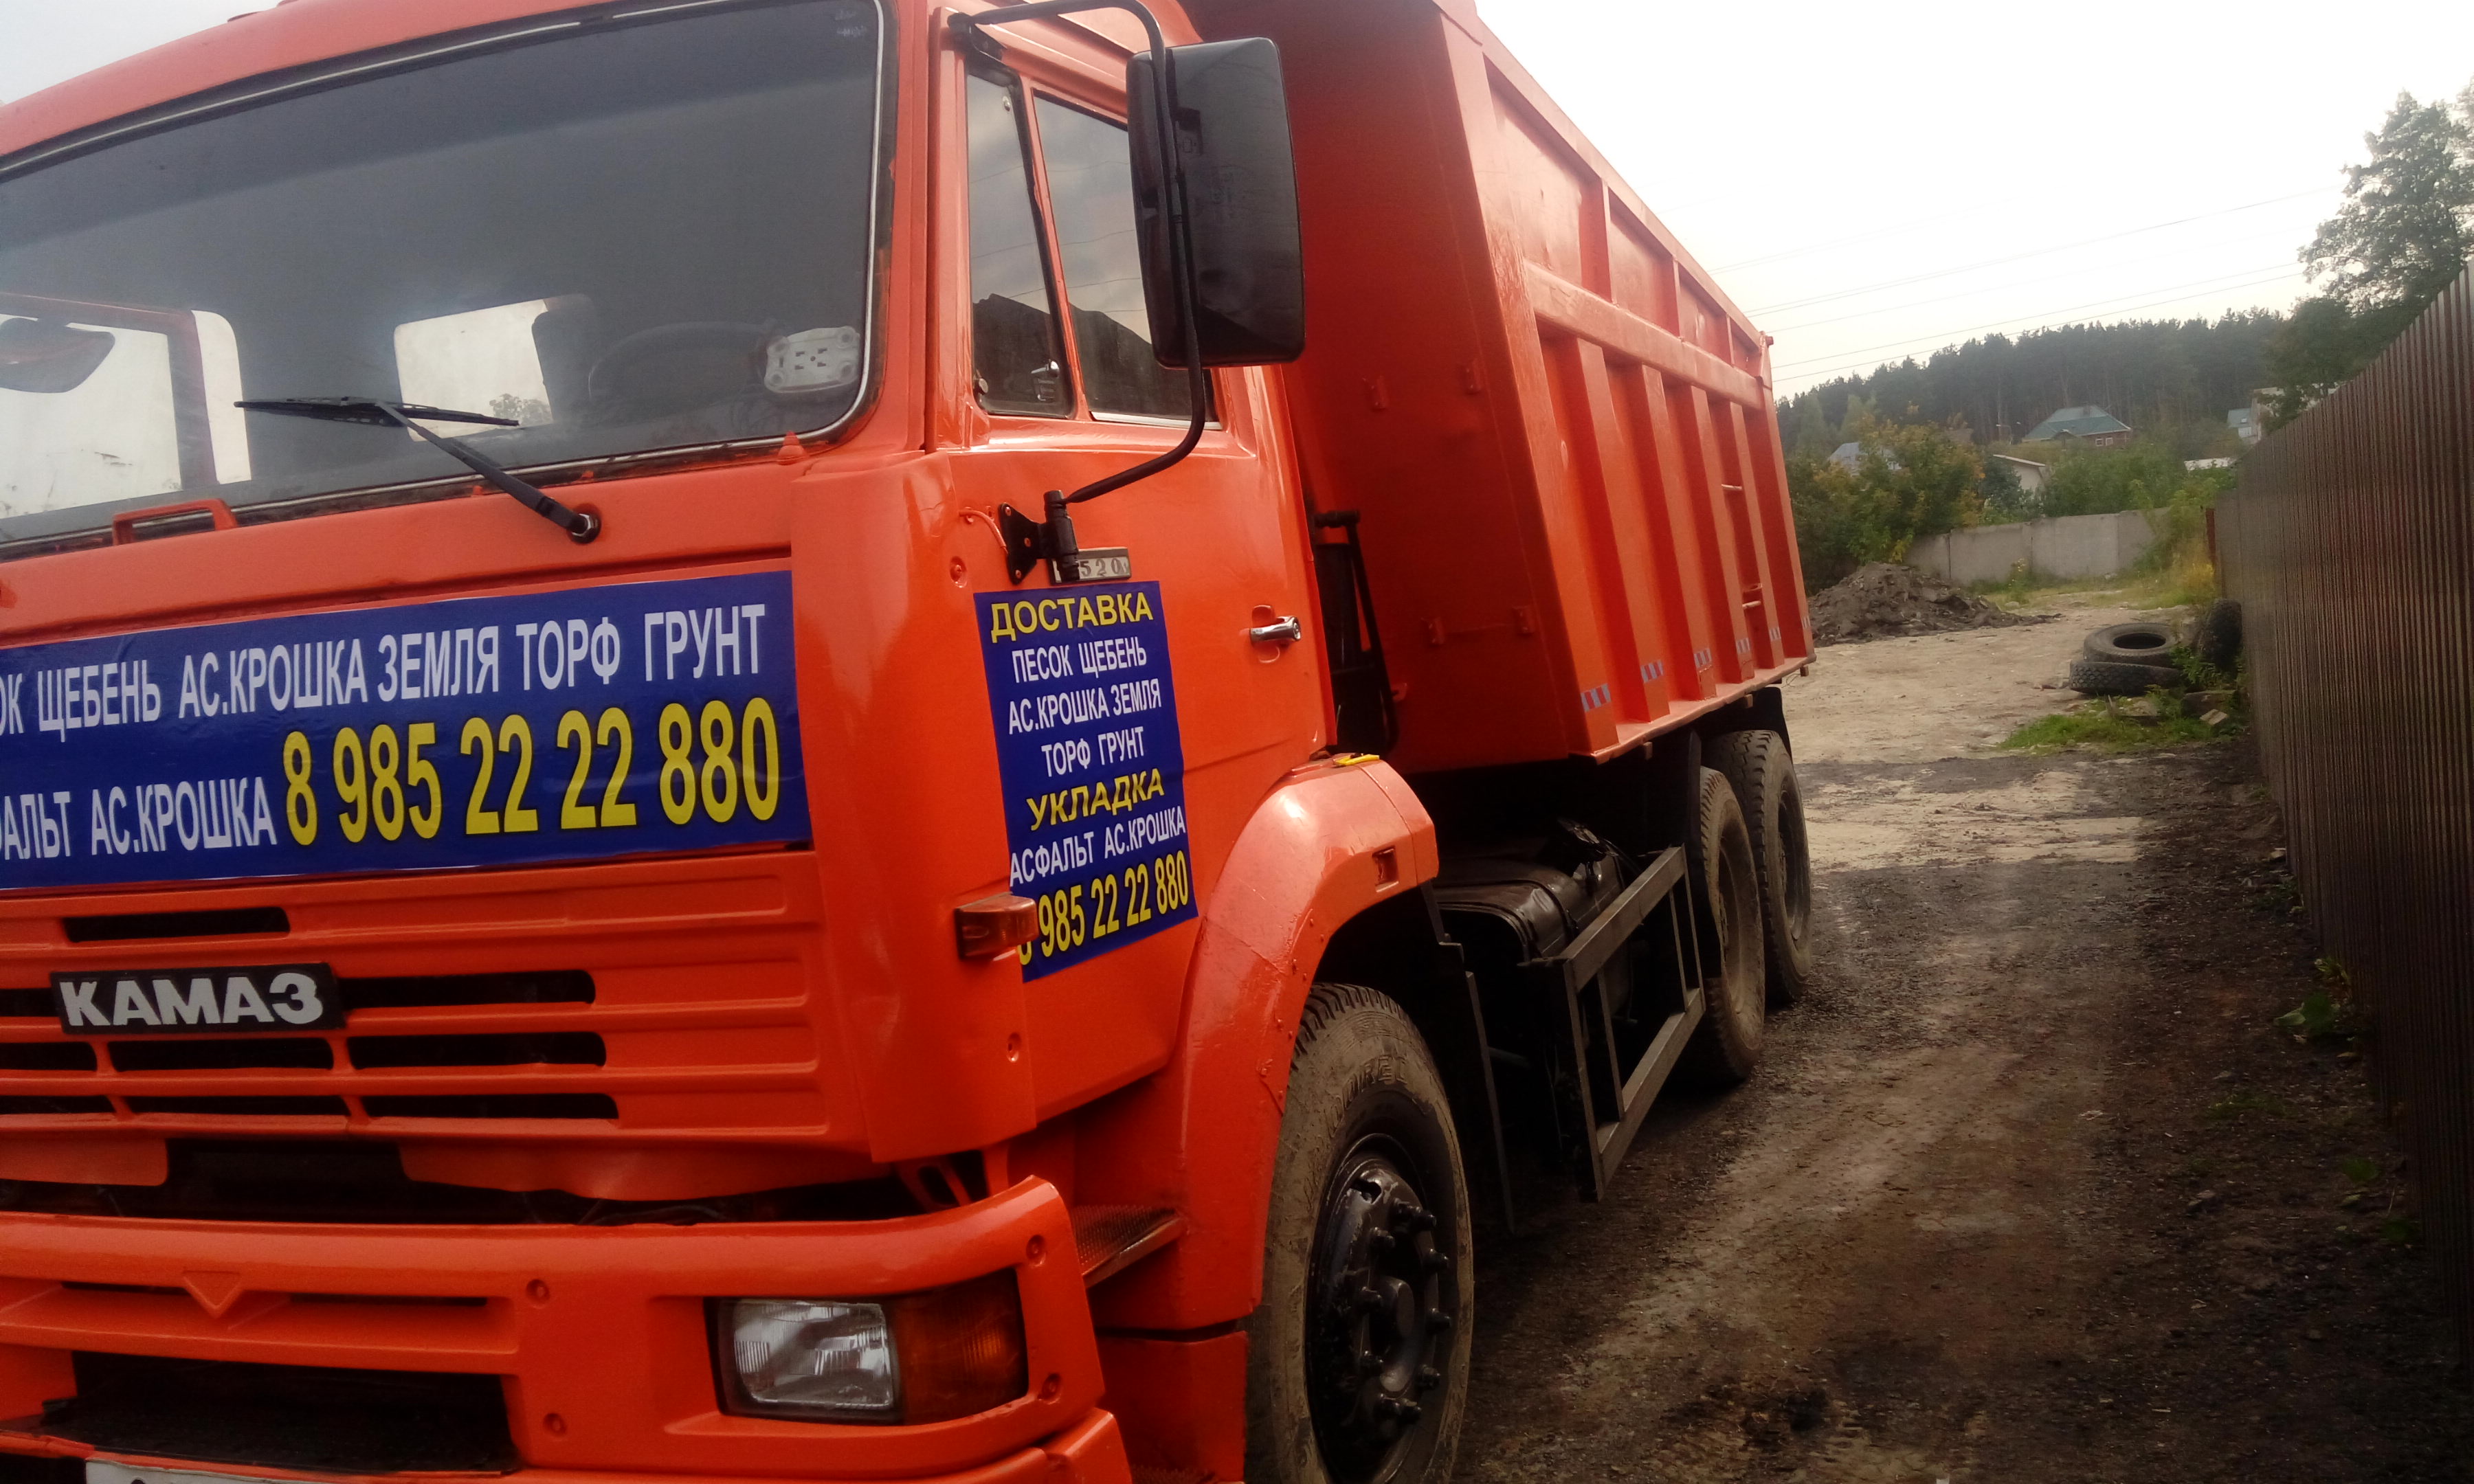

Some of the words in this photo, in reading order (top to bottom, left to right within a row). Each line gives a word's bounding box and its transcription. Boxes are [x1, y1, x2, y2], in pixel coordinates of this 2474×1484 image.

[1079, 557, 1122, 577] 520
[990, 592, 1154, 644] ДОСТАВКА
[38, 660, 161, 742] ЩЕБЕНЬ
[179, 639, 368, 718] АС.КРОШКА
[378, 626, 498, 701] ЗЕМЛЯ
[516, 617, 620, 690] ТОРФ
[645, 604, 765, 681] ГРУНТ
[1012, 645, 1073, 683] ПЕСОК
[1078, 637, 1146, 678] ЩЕБЕНЬ
[1009, 687, 1109, 734] АС.КРОШКА
[1111, 679, 1161, 715] ЗЕМЛЯ
[284, 732, 317, 845] 8
[333, 723, 441, 842] 985
[461, 715, 537, 834] 22
[557, 708, 636, 829] 22
[659, 698, 779, 824] 880
[1041, 739, 1090, 776] ТОРФ
[1098, 726, 1144, 765] ГРУНТ
[0, 791, 70, 859] АЛЬТ
[92, 777, 277, 855] АС.КРОШКА
[1026, 768, 1165, 831] УКЛАДКА
[1010, 831, 1094, 887] АСФАЛЬТ
[1104, 805, 1186, 859] АС.КРОШКА
[1039, 885, 1084, 956] 985
[1091, 875, 1119, 938] 22
[1125, 864, 1150, 926] 22
[1155, 851, 1188, 914] 880
[60, 972, 324, 1026] КАМАЗ
